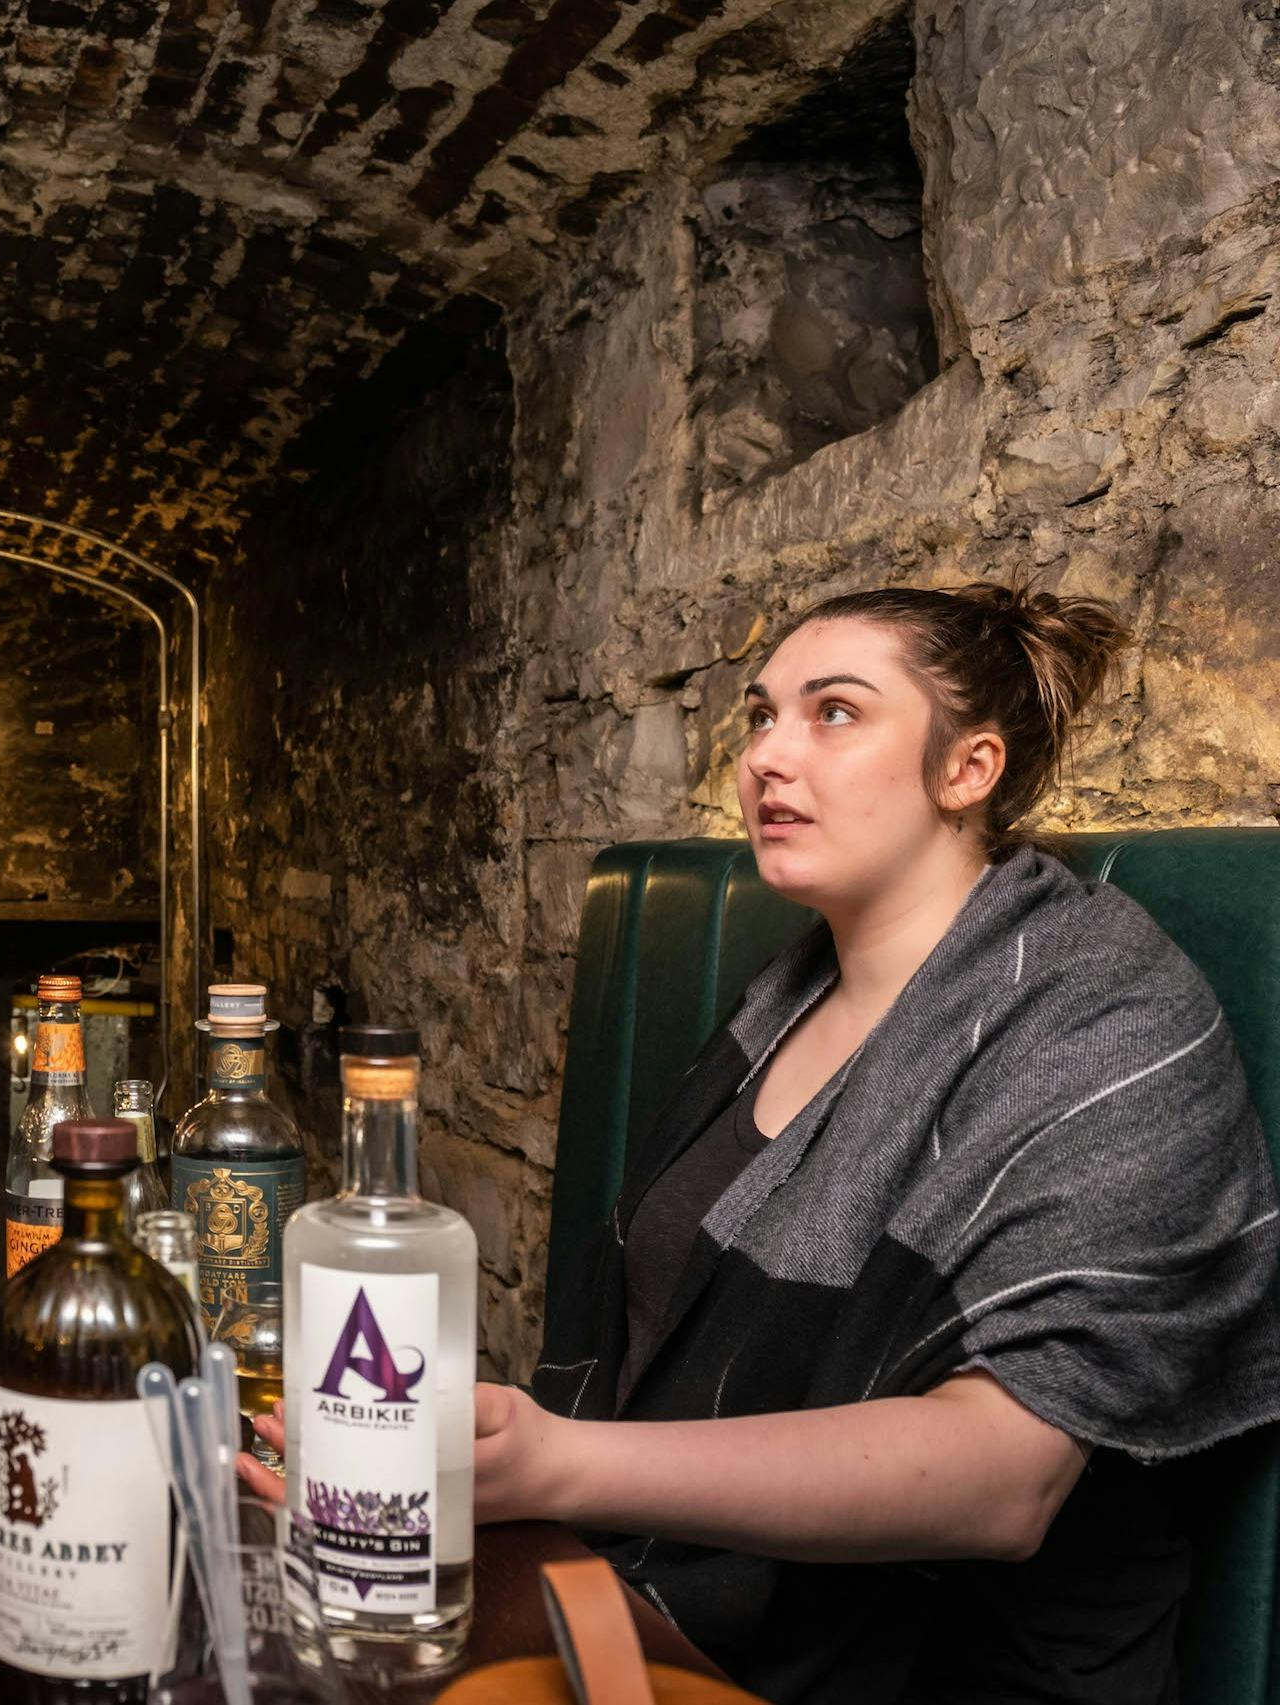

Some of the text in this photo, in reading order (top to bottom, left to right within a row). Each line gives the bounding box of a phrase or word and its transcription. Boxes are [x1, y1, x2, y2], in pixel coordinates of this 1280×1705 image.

[10, 1238, 49, 1254] GINGE
[318, 1399, 417, 1423] ARBIKIE
[41, 1541, 128, 1565] ABBEY
[389, 1538, 421, 1553] GIN
